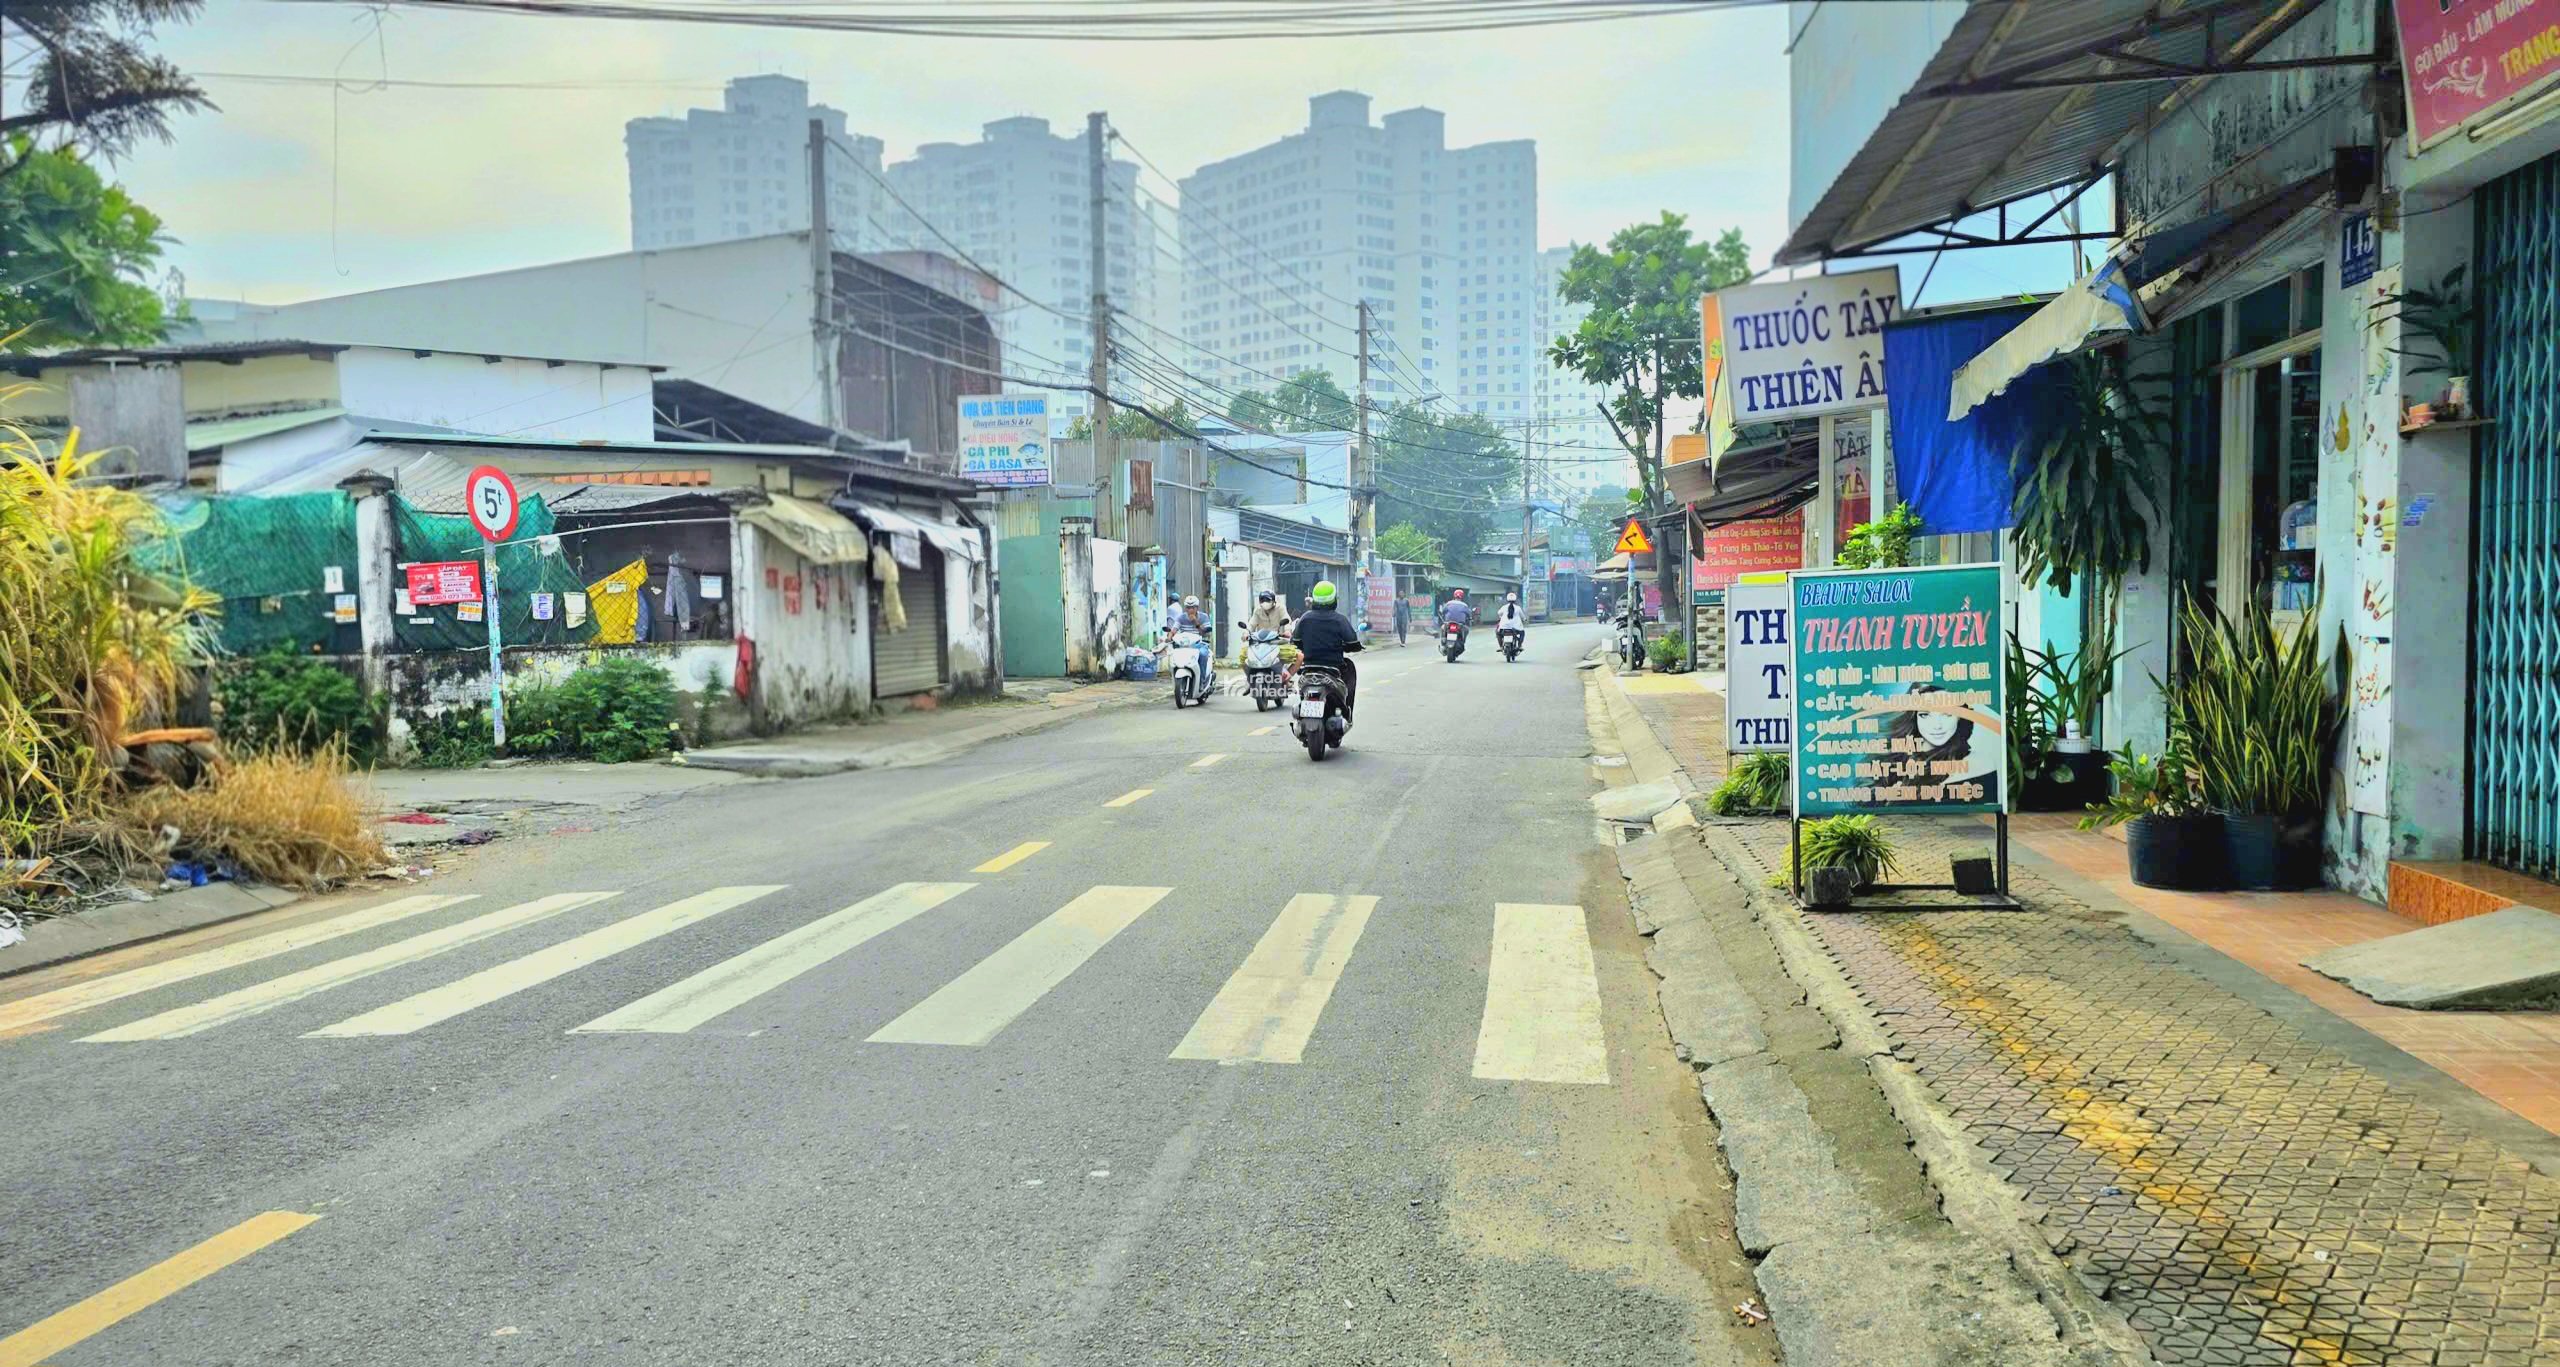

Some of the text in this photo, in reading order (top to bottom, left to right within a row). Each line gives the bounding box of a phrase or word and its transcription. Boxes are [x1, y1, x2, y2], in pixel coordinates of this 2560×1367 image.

[2466, 11, 2494, 43] LÀM
[2499, 24, 2560, 83] TRANG
[2345, 219, 2376, 262] 145
[1733, 289, 1897, 352] THUỐC TÂY
[1741, 358, 1844, 413] THIÊN
[1017, 399, 1045, 415] GIANG
[990, 457, 1022, 470] BASA
[1801, 578, 1914, 607] BEAUTY SALON
[1803, 597, 1991, 654] THANH TUYỀN
[1816, 665, 1837, 689] GỘI
[1872, 664, 1896, 684] LÀM
[1897, 662, 1934, 683] MÓNG
[1943, 661, 1967, 681] SƠN
[1970, 661, 1991, 680] GEL
[1817, 714, 1879, 735] UỐN MI
[1817, 735, 1924, 756] MASSAGE MẶT
[1818, 763, 1851, 782] CẠO
[1819, 786, 1871, 803] TRANG
[1921, 782, 1945, 803] DỰ
[1947, 781, 1983, 803] TIỆC
